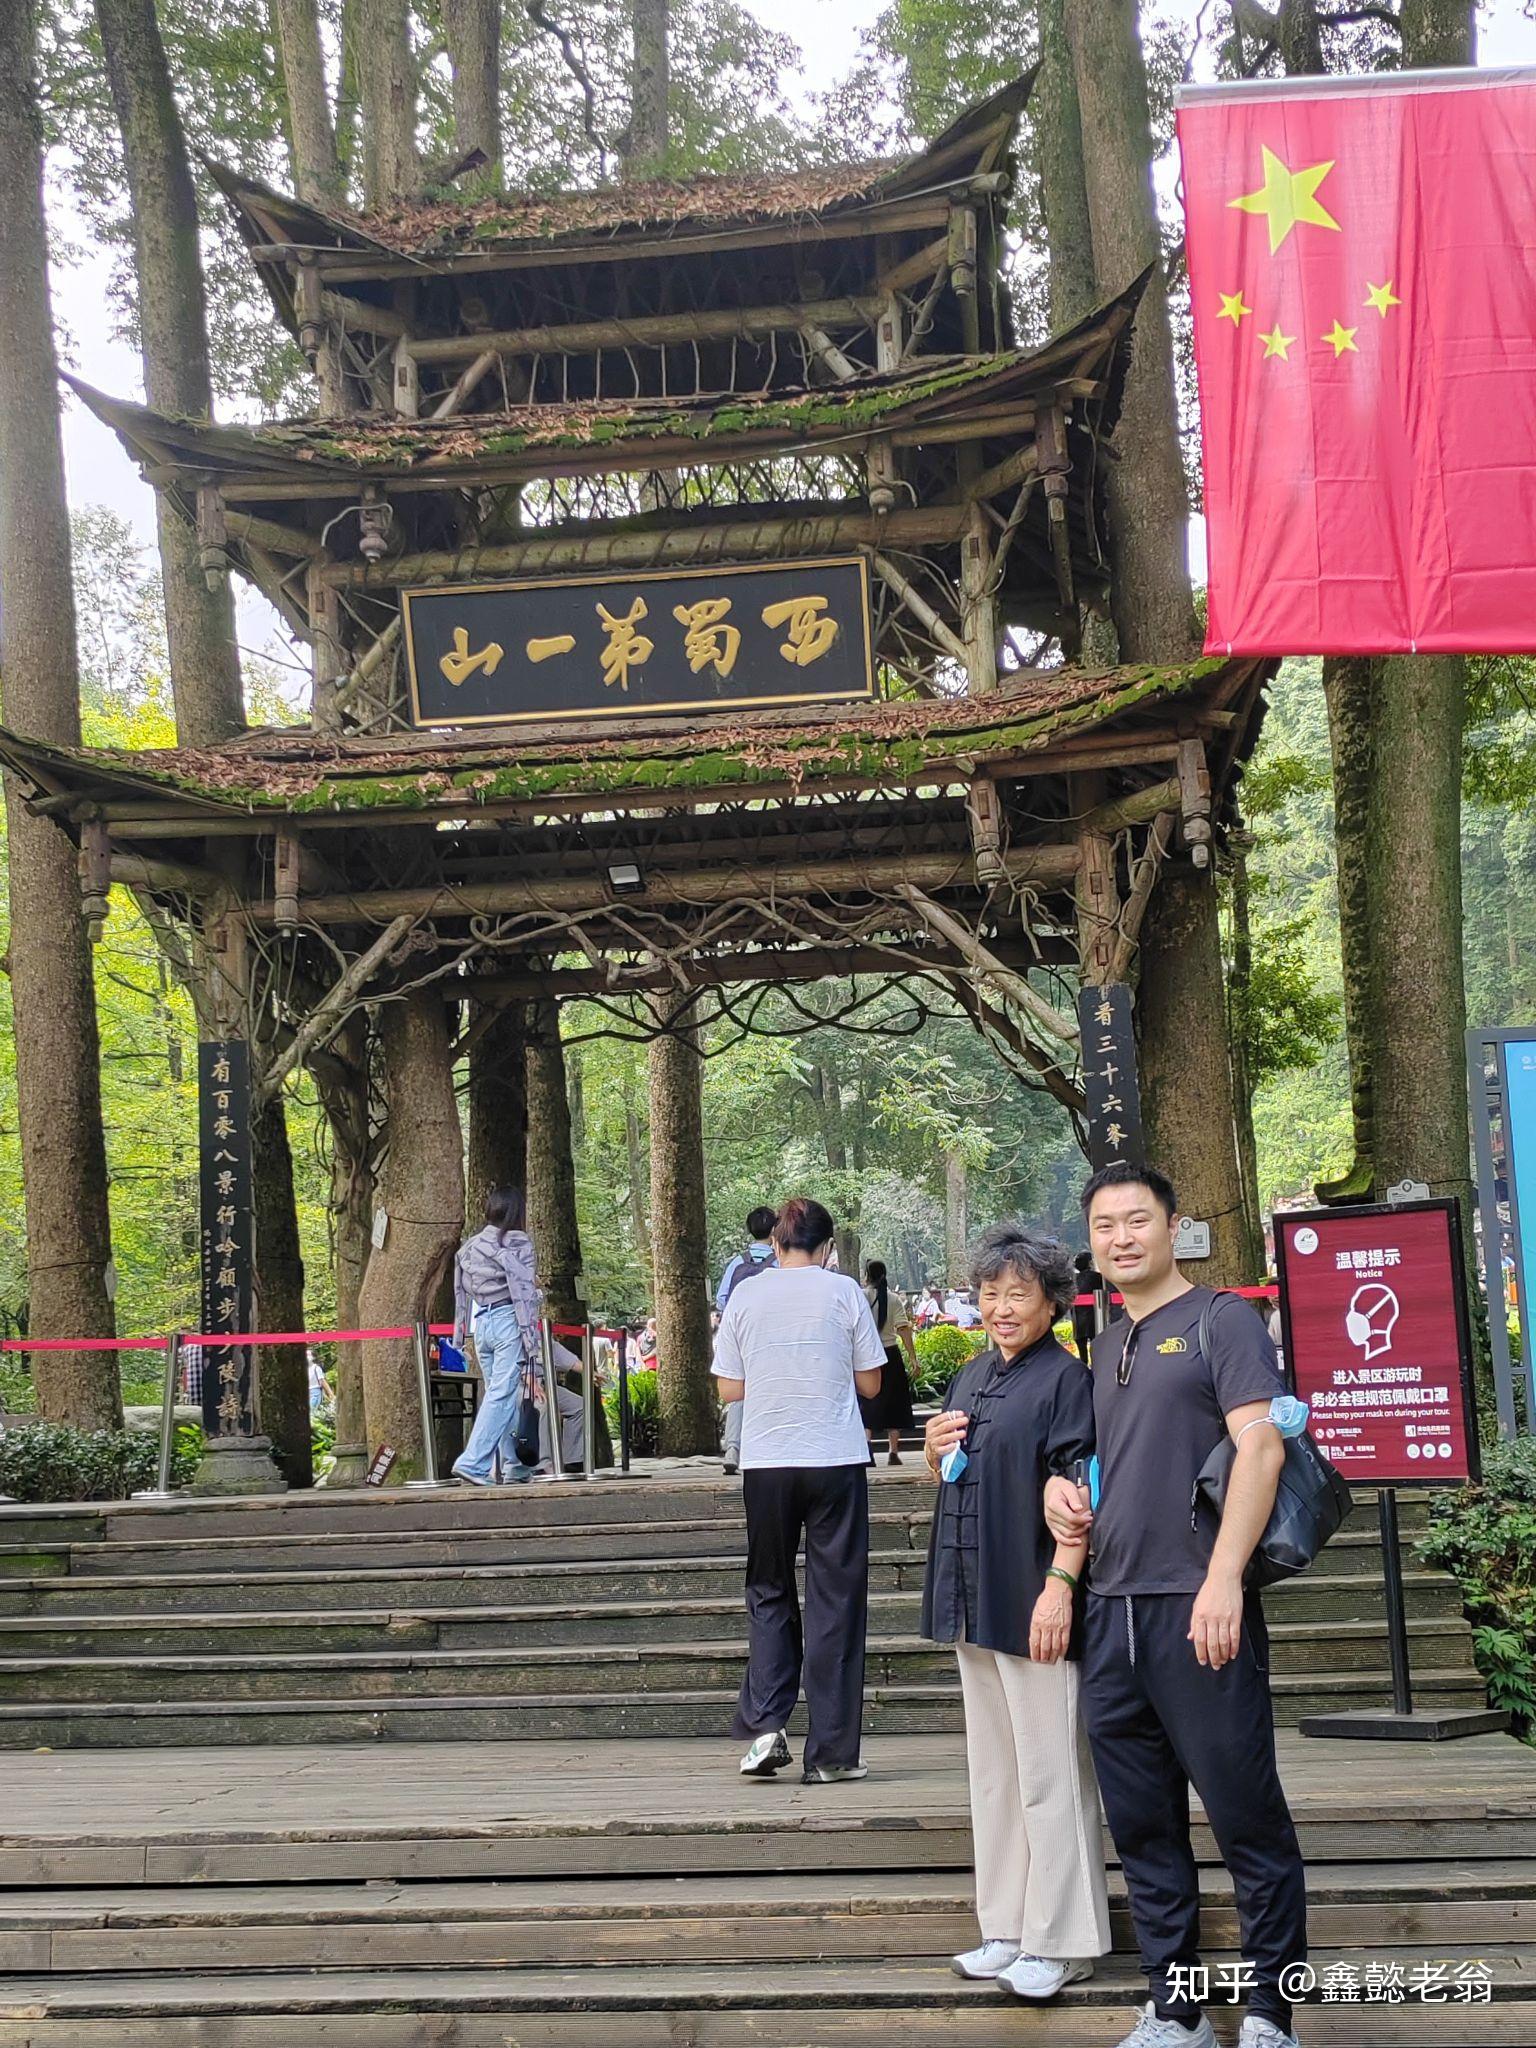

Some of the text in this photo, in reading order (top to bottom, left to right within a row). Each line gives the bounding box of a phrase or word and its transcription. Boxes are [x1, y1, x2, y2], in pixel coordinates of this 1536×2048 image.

[1335, 1248, 1402, 1270] 温馨提示
[1355, 1270, 1383, 1279] Notice
[1333, 1367, 1423, 1385] 进入景区游玩时
[1311, 1387, 1450, 1408] 务必全程规范佩戴口罩
[1311, 1411, 1333, 1420] Please
[1333, 1411, 1350, 1420] keep
[1350, 1411, 1365, 1420] your
[1366, 1409, 1384, 1418] mask
[1394, 1408, 1417, 1418] during
[1417, 1408, 1434, 1418] your
